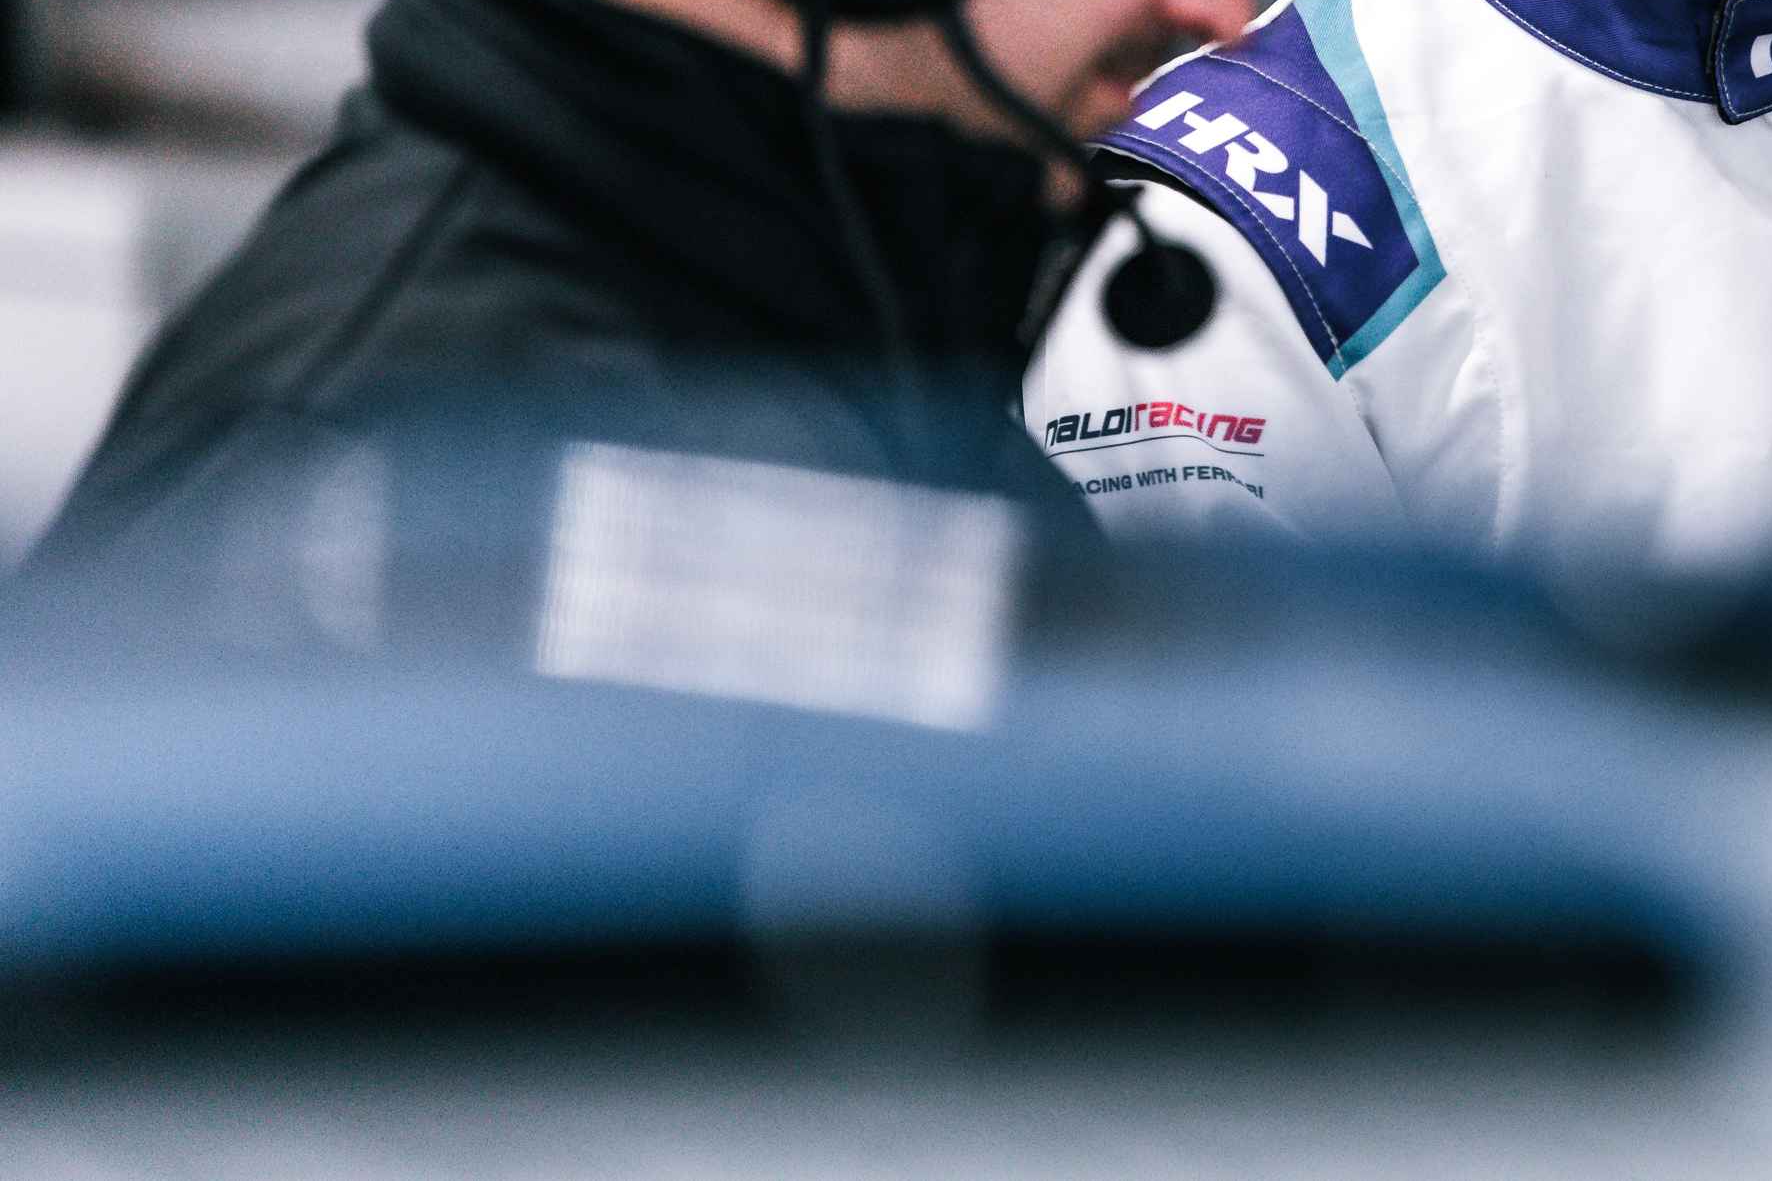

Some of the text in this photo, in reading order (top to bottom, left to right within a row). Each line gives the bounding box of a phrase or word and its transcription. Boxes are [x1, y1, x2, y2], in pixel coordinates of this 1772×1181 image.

[1133, 90, 1374, 268] HRX
[1073, 465, 1264, 500] ACING WITH FERRI
